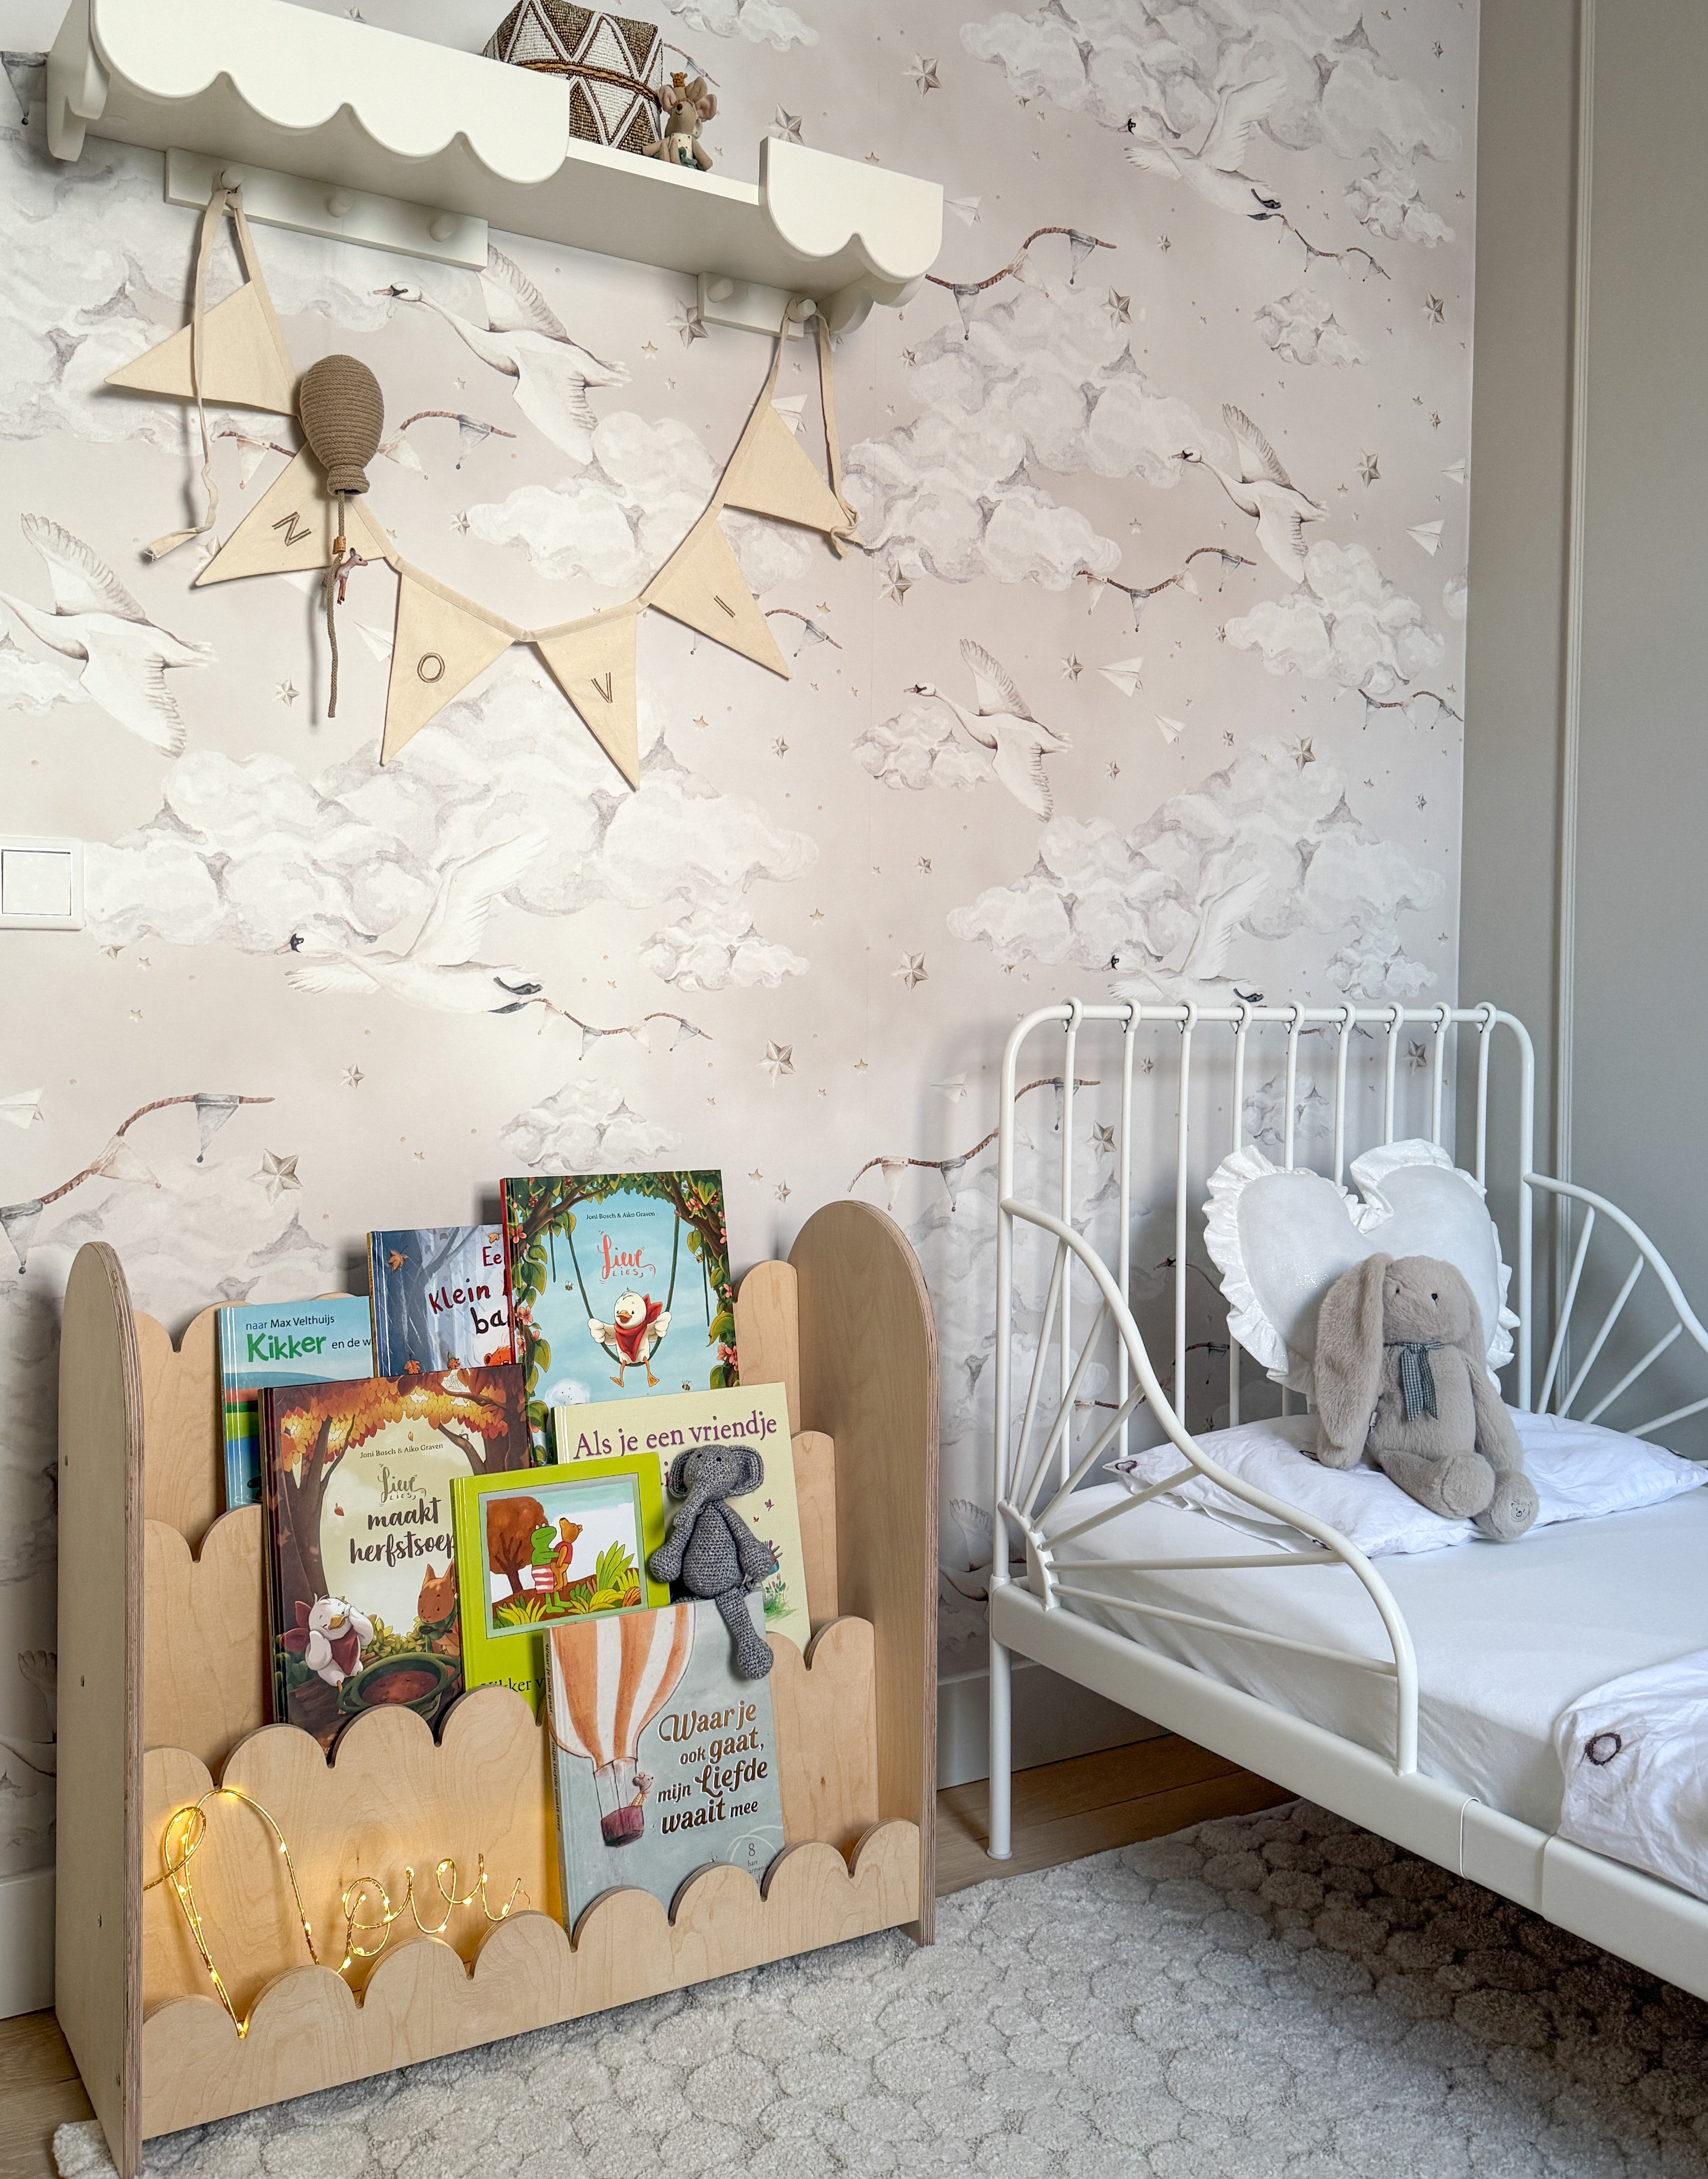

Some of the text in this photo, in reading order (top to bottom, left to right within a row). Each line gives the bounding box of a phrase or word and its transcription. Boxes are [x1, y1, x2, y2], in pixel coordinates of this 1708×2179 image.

[482, 1246, 503, 1267] Ee
[246, 1314, 335, 1330] naar Max Velthuijs
[470, 1307, 510, 1335] ba
[247, 1332, 327, 1362] Kikker
[332, 1341, 345, 1349] en
[347, 1338, 360, 1348] de
[573, 1410, 777, 1459] Als je een vriendje
[376, 1448, 396, 1457] Bosch
[368, 1497, 442, 1530] maakt
[658, 1700, 757, 1743] Waar je
[680, 1726, 764, 1765] ook gaat,
[657, 1757, 768, 1803] mijn Liefde
[661, 1797, 759, 1835] waait mee
[749, 1843, 756, 1857] 8
